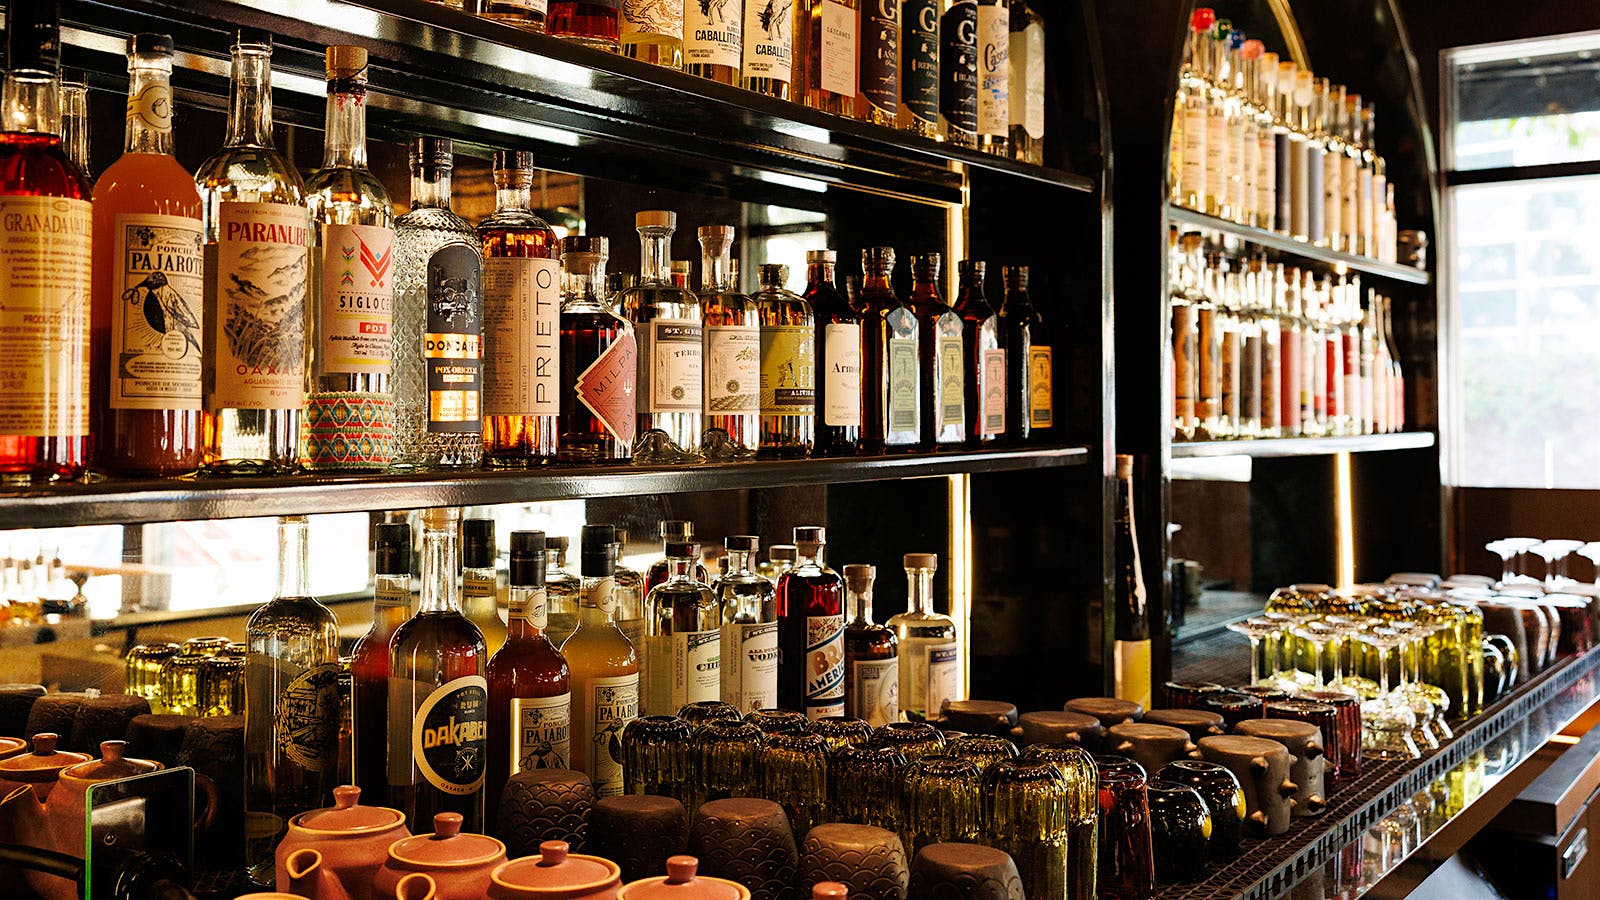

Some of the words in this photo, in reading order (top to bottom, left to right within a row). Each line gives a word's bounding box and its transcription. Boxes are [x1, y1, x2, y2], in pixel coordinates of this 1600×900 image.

[365, 324, 385, 333] POX
[536, 268, 552, 406] PRIETO
[593, 349, 632, 396] MILPA
[460, 699, 479, 711] RUM
